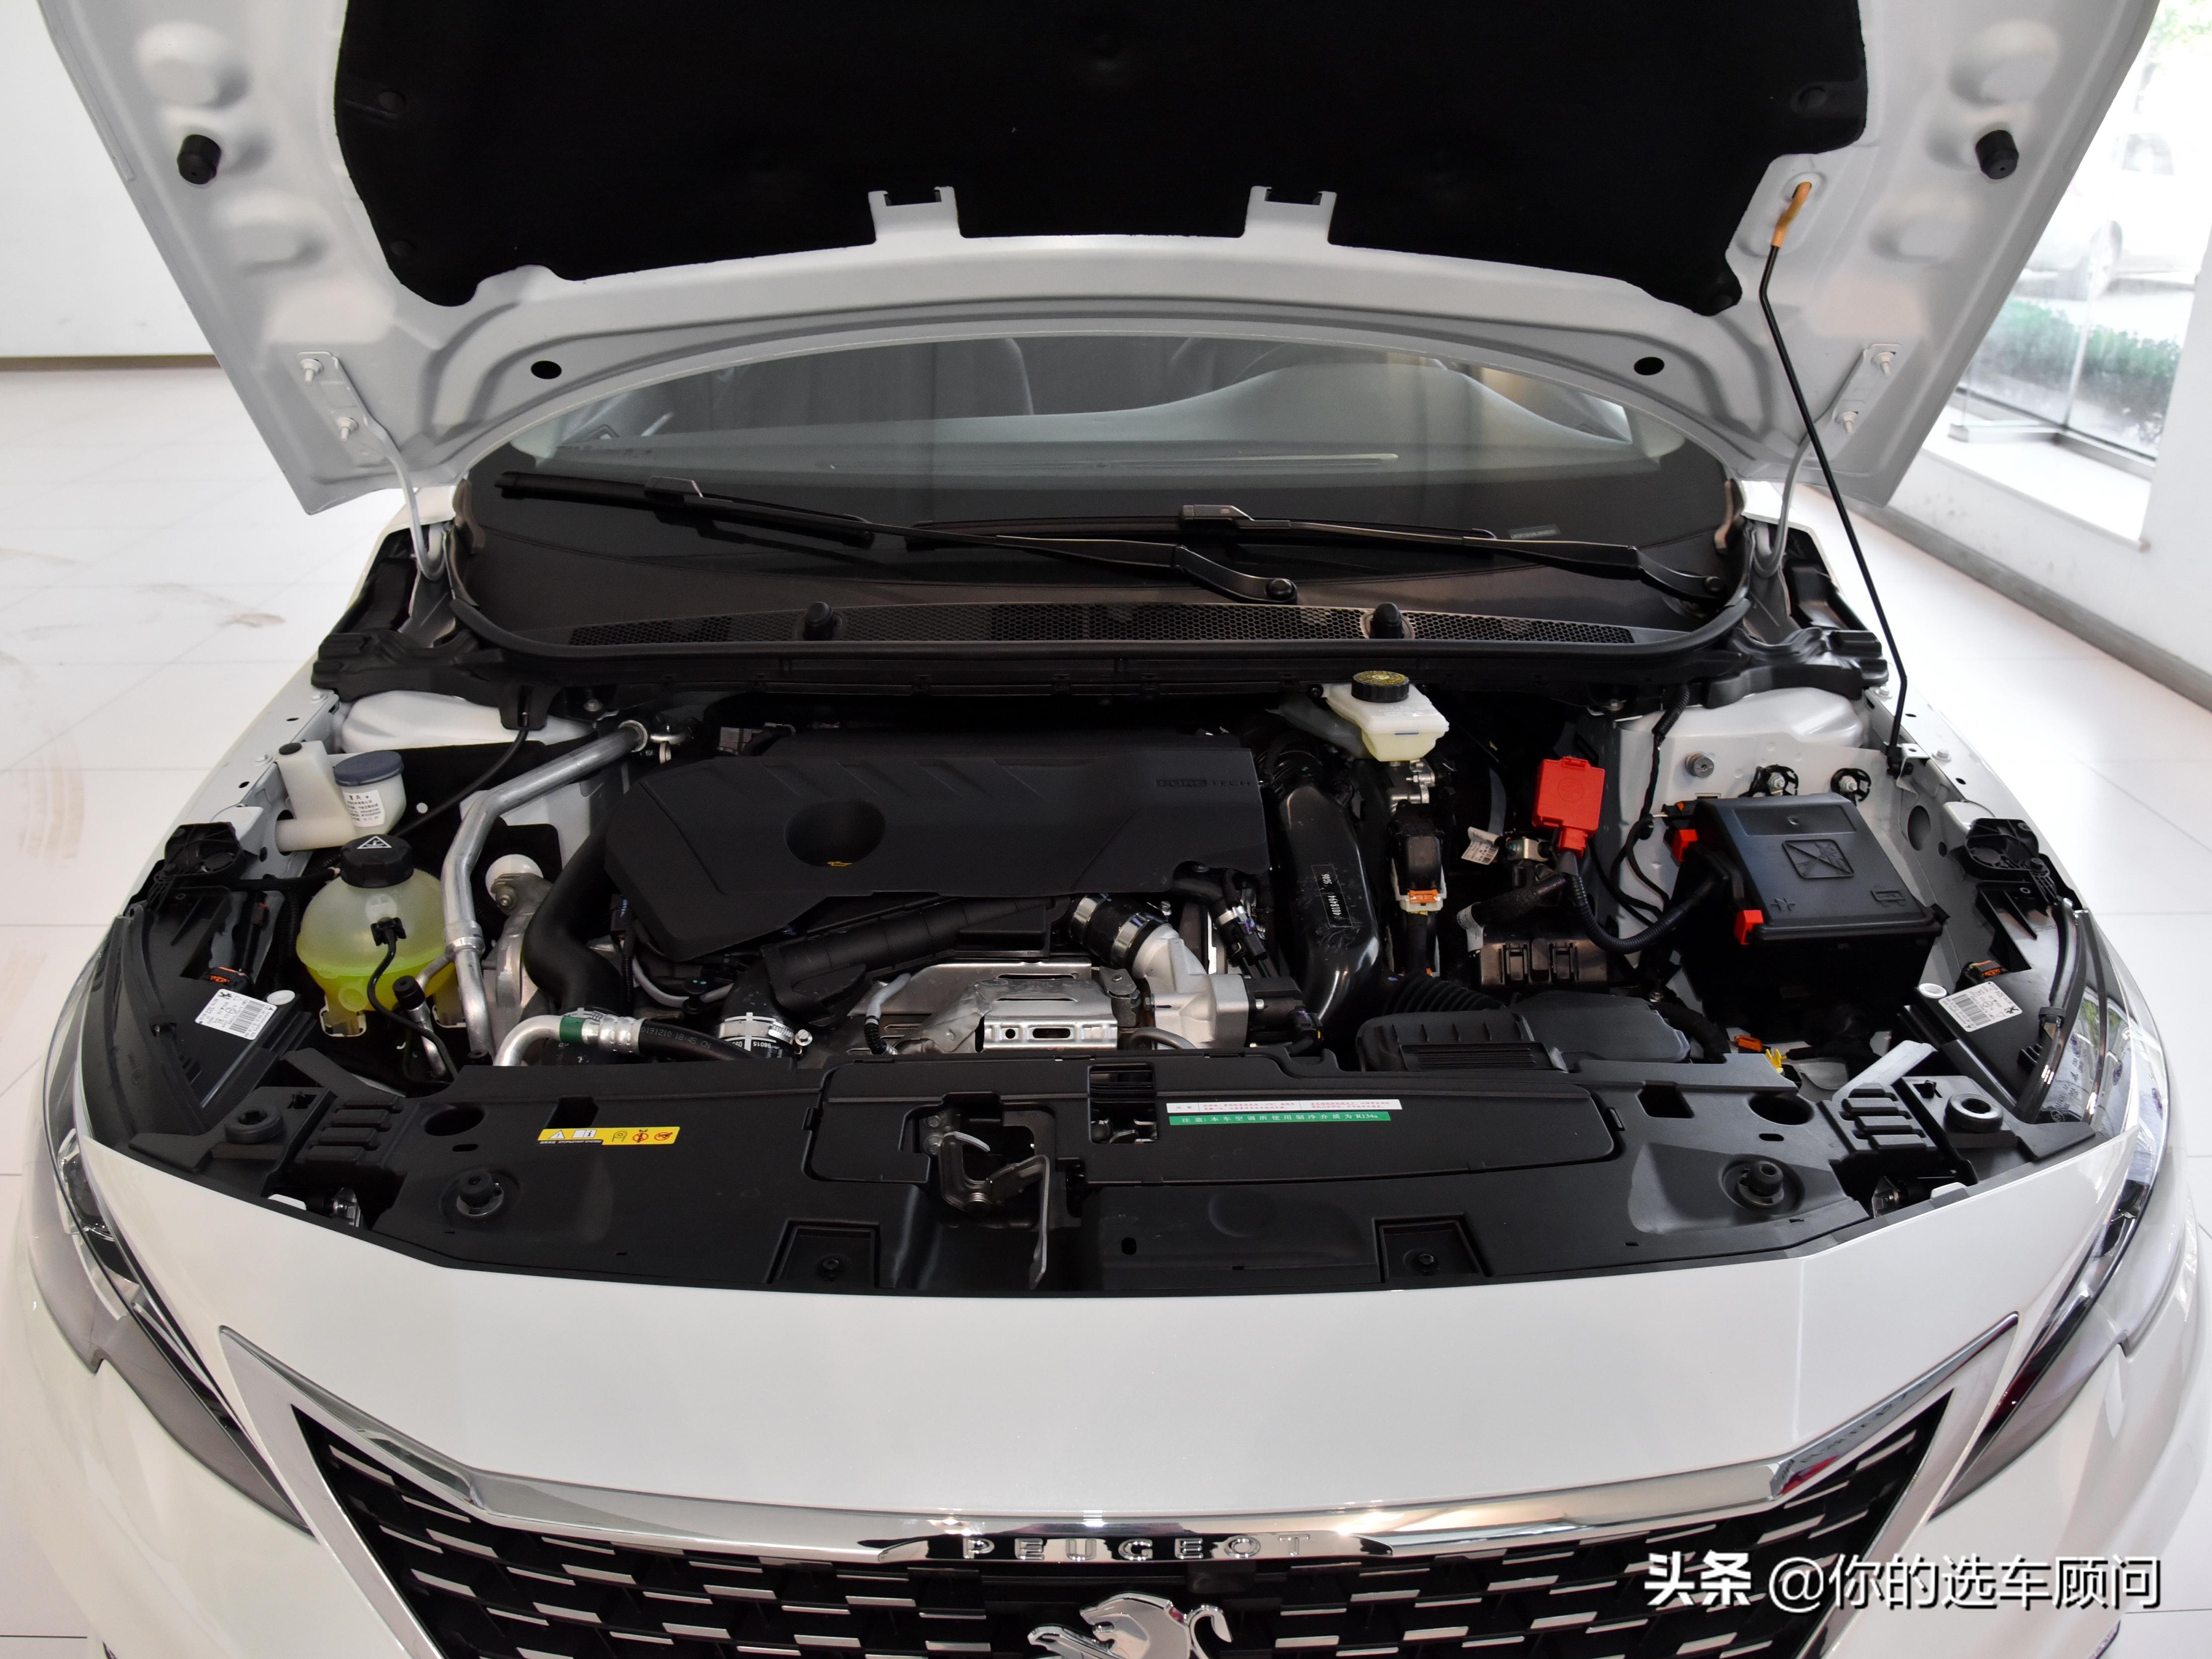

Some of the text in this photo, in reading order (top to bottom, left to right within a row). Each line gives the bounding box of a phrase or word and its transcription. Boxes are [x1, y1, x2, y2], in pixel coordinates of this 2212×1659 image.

[1327, 895, 1342, 915] 4018494
[639, 1027, 672, 1037] 0191210
[962, 1534, 1311, 1560] PEUGEOT
